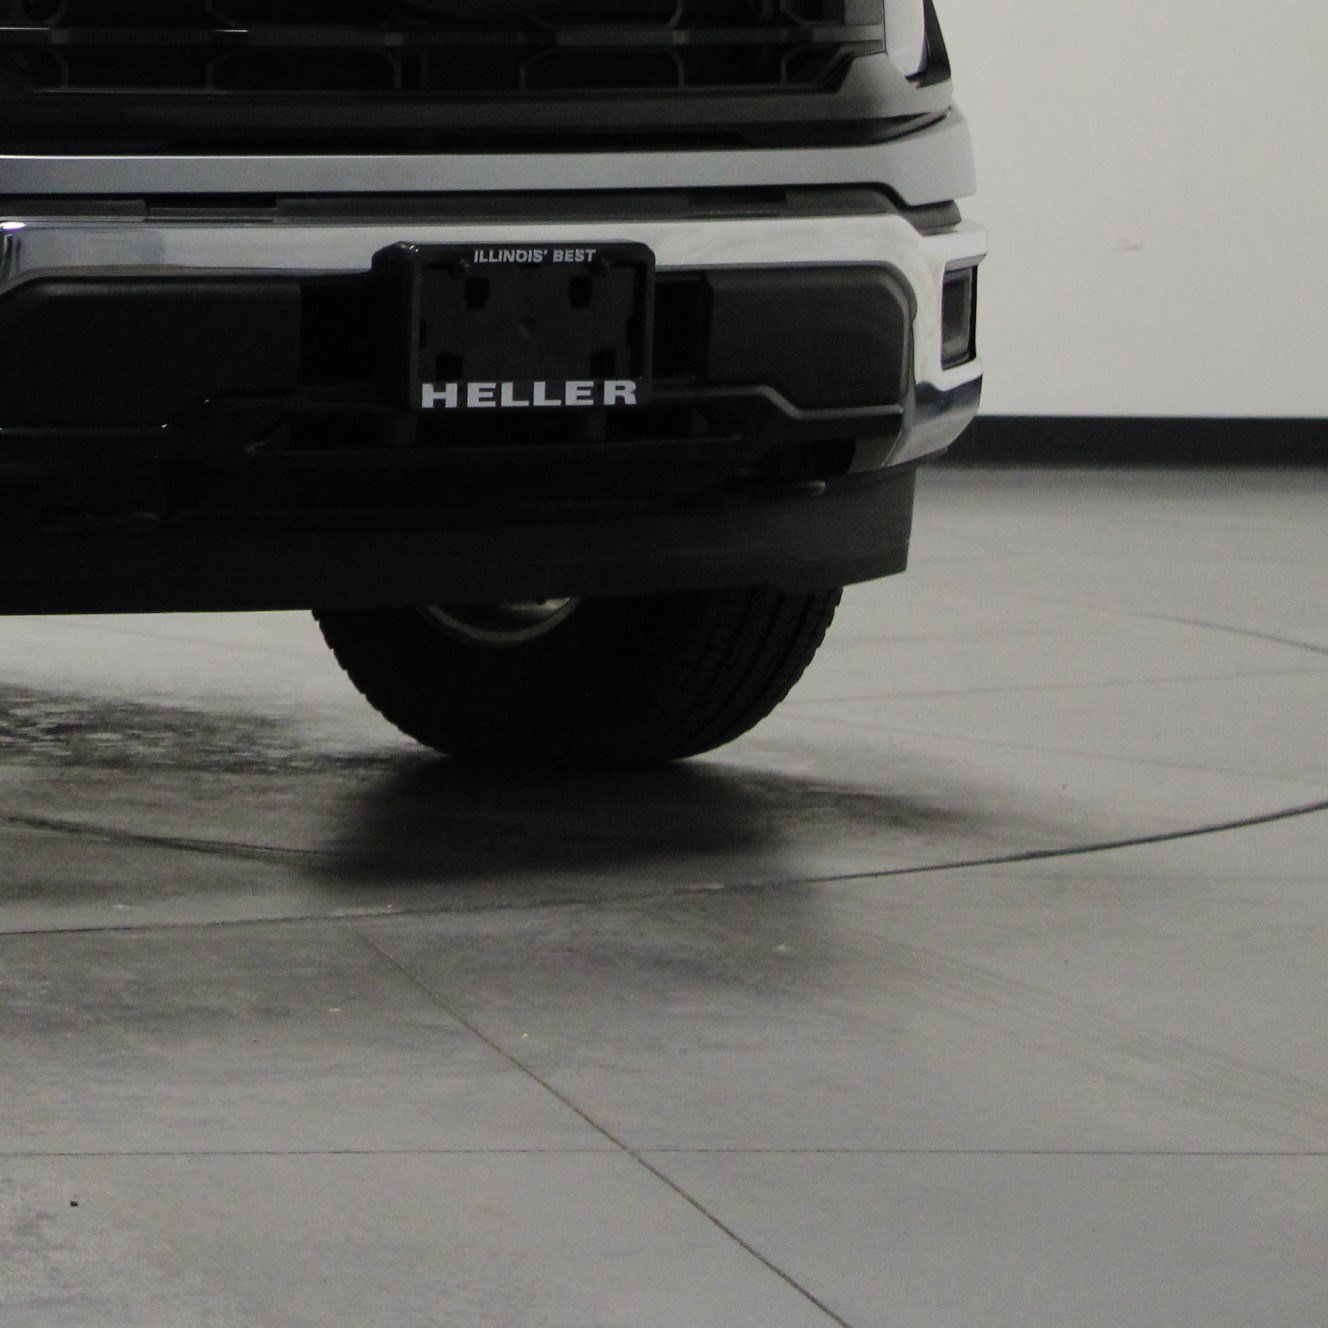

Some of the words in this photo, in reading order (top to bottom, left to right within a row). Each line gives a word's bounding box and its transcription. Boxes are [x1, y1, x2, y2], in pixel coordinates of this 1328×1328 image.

[474, 249, 548, 263] ILLINOIS'
[552, 248, 597, 263] BEST
[422, 380, 637, 408] HELLER
